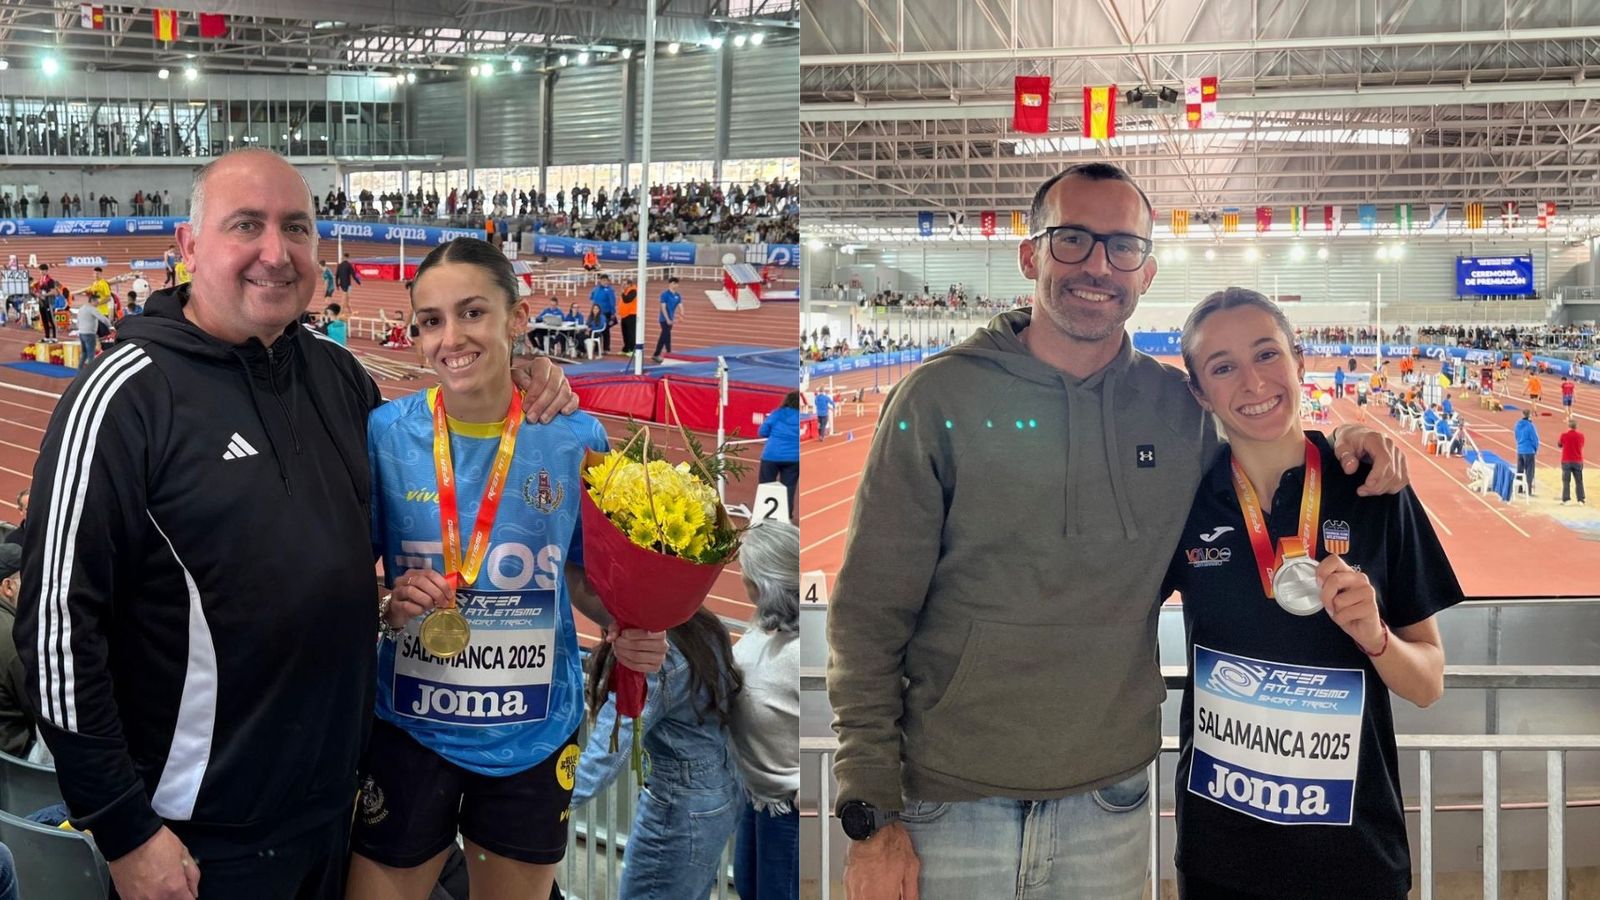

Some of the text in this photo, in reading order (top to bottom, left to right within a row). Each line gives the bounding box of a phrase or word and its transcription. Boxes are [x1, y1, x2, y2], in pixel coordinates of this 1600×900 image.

[330, 223, 374, 237] Joma
[385, 226, 427, 240] Joma
[1471, 270, 1517, 278] CEREMONIA
[1477, 276, 1526, 285] PREMIACIÓN
[763, 497, 779, 520] 2
[804, 583, 818, 603] 4
[471, 596, 522, 608] RFEA
[465, 608, 542, 616] ATLETISMO
[500, 619, 533, 627] TRACK
[508, 645, 546, 669] 2025
[1270, 669, 1328, 686] RFEA
[1263, 683, 1349, 699] ATLETISMO
[412, 684, 528, 717] Joma
[1257, 694, 1338, 711] SHORT TRACK
[1199, 707, 1351, 760] SALAMANCA 2025
[1208, 763, 1330, 815] Joma
